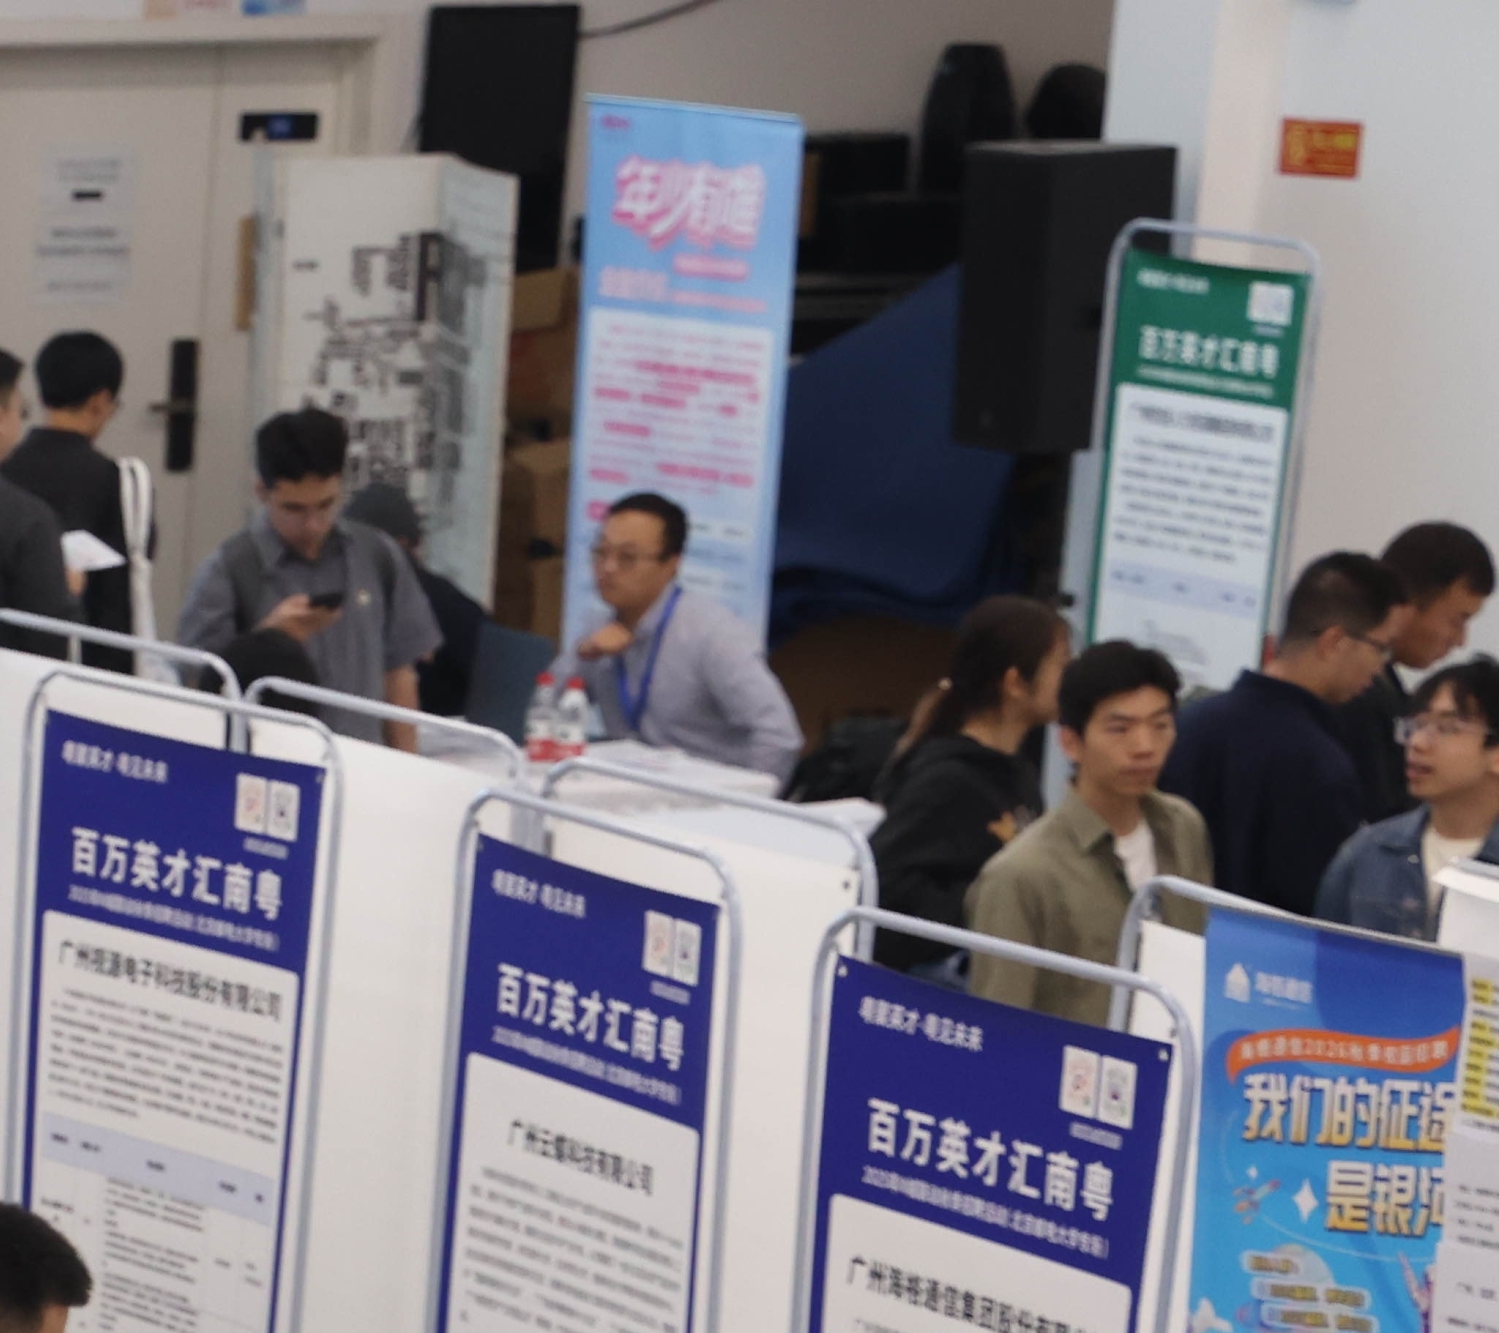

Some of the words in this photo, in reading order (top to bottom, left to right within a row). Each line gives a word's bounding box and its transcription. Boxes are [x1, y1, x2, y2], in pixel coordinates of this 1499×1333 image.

[70, 825, 284, 921] 百万英才汇南粤
[496, 962, 686, 1072] 百万英才汇南粤
[867, 1096, 1115, 1222] 百万英才汇南粤
